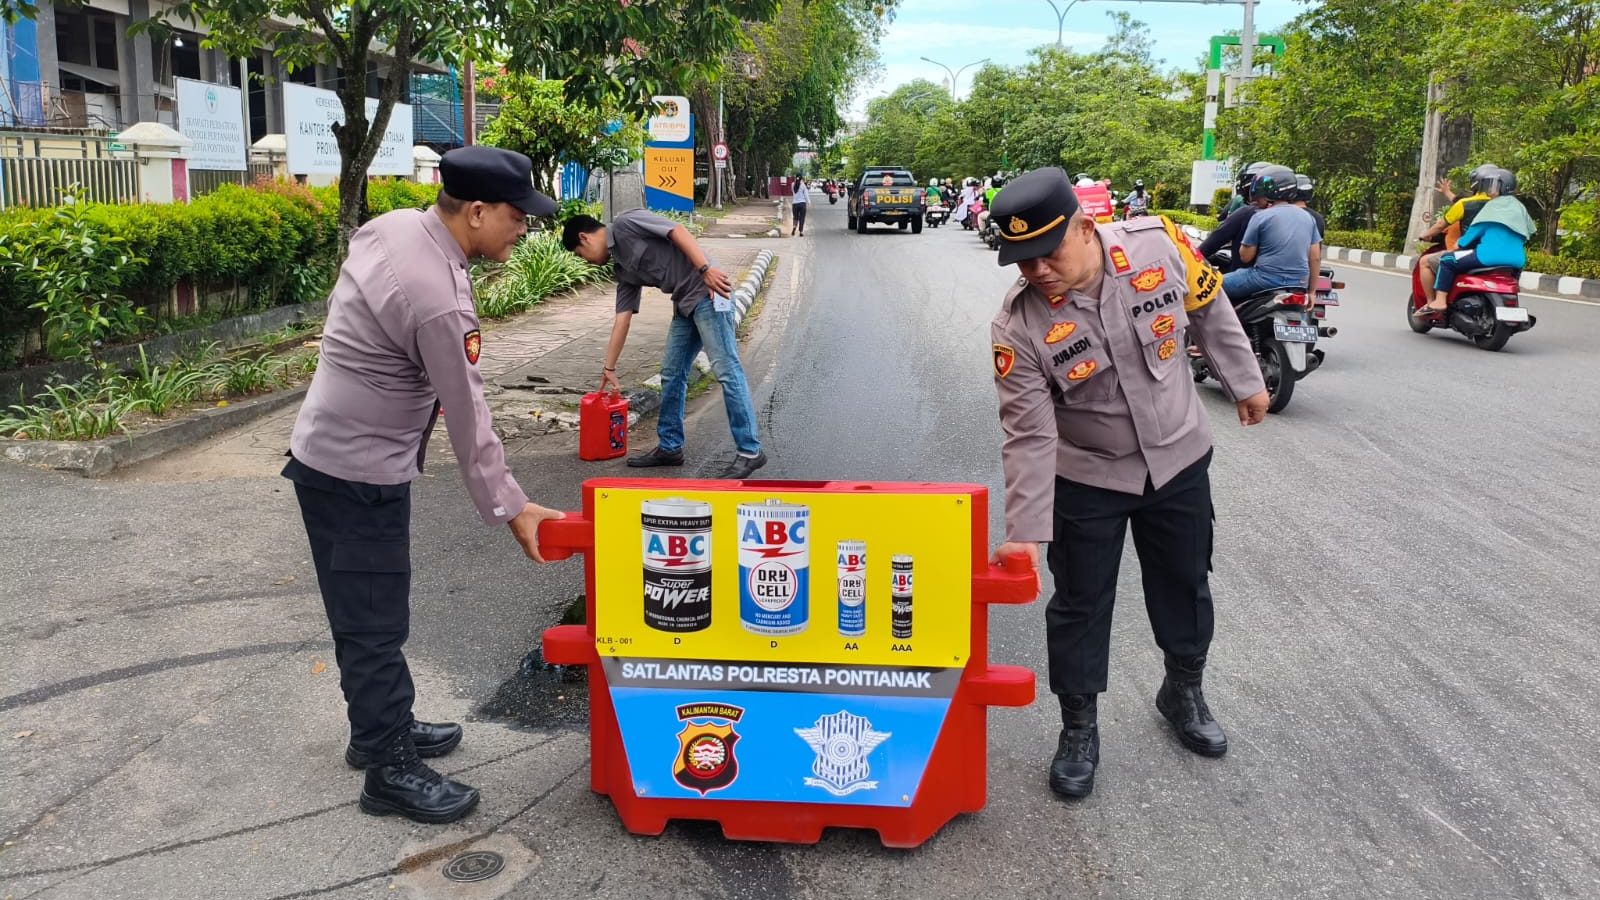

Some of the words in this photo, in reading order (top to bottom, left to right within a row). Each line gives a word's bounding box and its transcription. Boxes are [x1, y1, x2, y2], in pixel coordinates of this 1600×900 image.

[299, 122, 325, 136] KANTOR
[876, 195, 913, 205] POLISI
[1132, 290, 1178, 318] POLRI
[1052, 336, 1092, 367] JUBAEDI
[742, 520, 805, 545] ABC
[648, 534, 704, 556] ABC
[838, 553, 866, 566] ABC
[758, 570, 788, 582] DRY
[892, 574, 912, 586] ABC
[659, 578, 695, 590] Super
[842, 580, 861, 588] DRY
[757, 584, 790, 597] CELL
[842, 590, 862, 598] CELL
[644, 584, 710, 610] POWER
[844, 642, 858, 650] AA
[891, 644, 913, 652] AAA
[622, 662, 723, 680] SATLANTAS
[728, 666, 822, 685] POLRESTA
[824, 669, 931, 688] PONTIANAK
[682, 706, 718, 716] KALIMANTAN
[720, 707, 738, 718] BARAT
